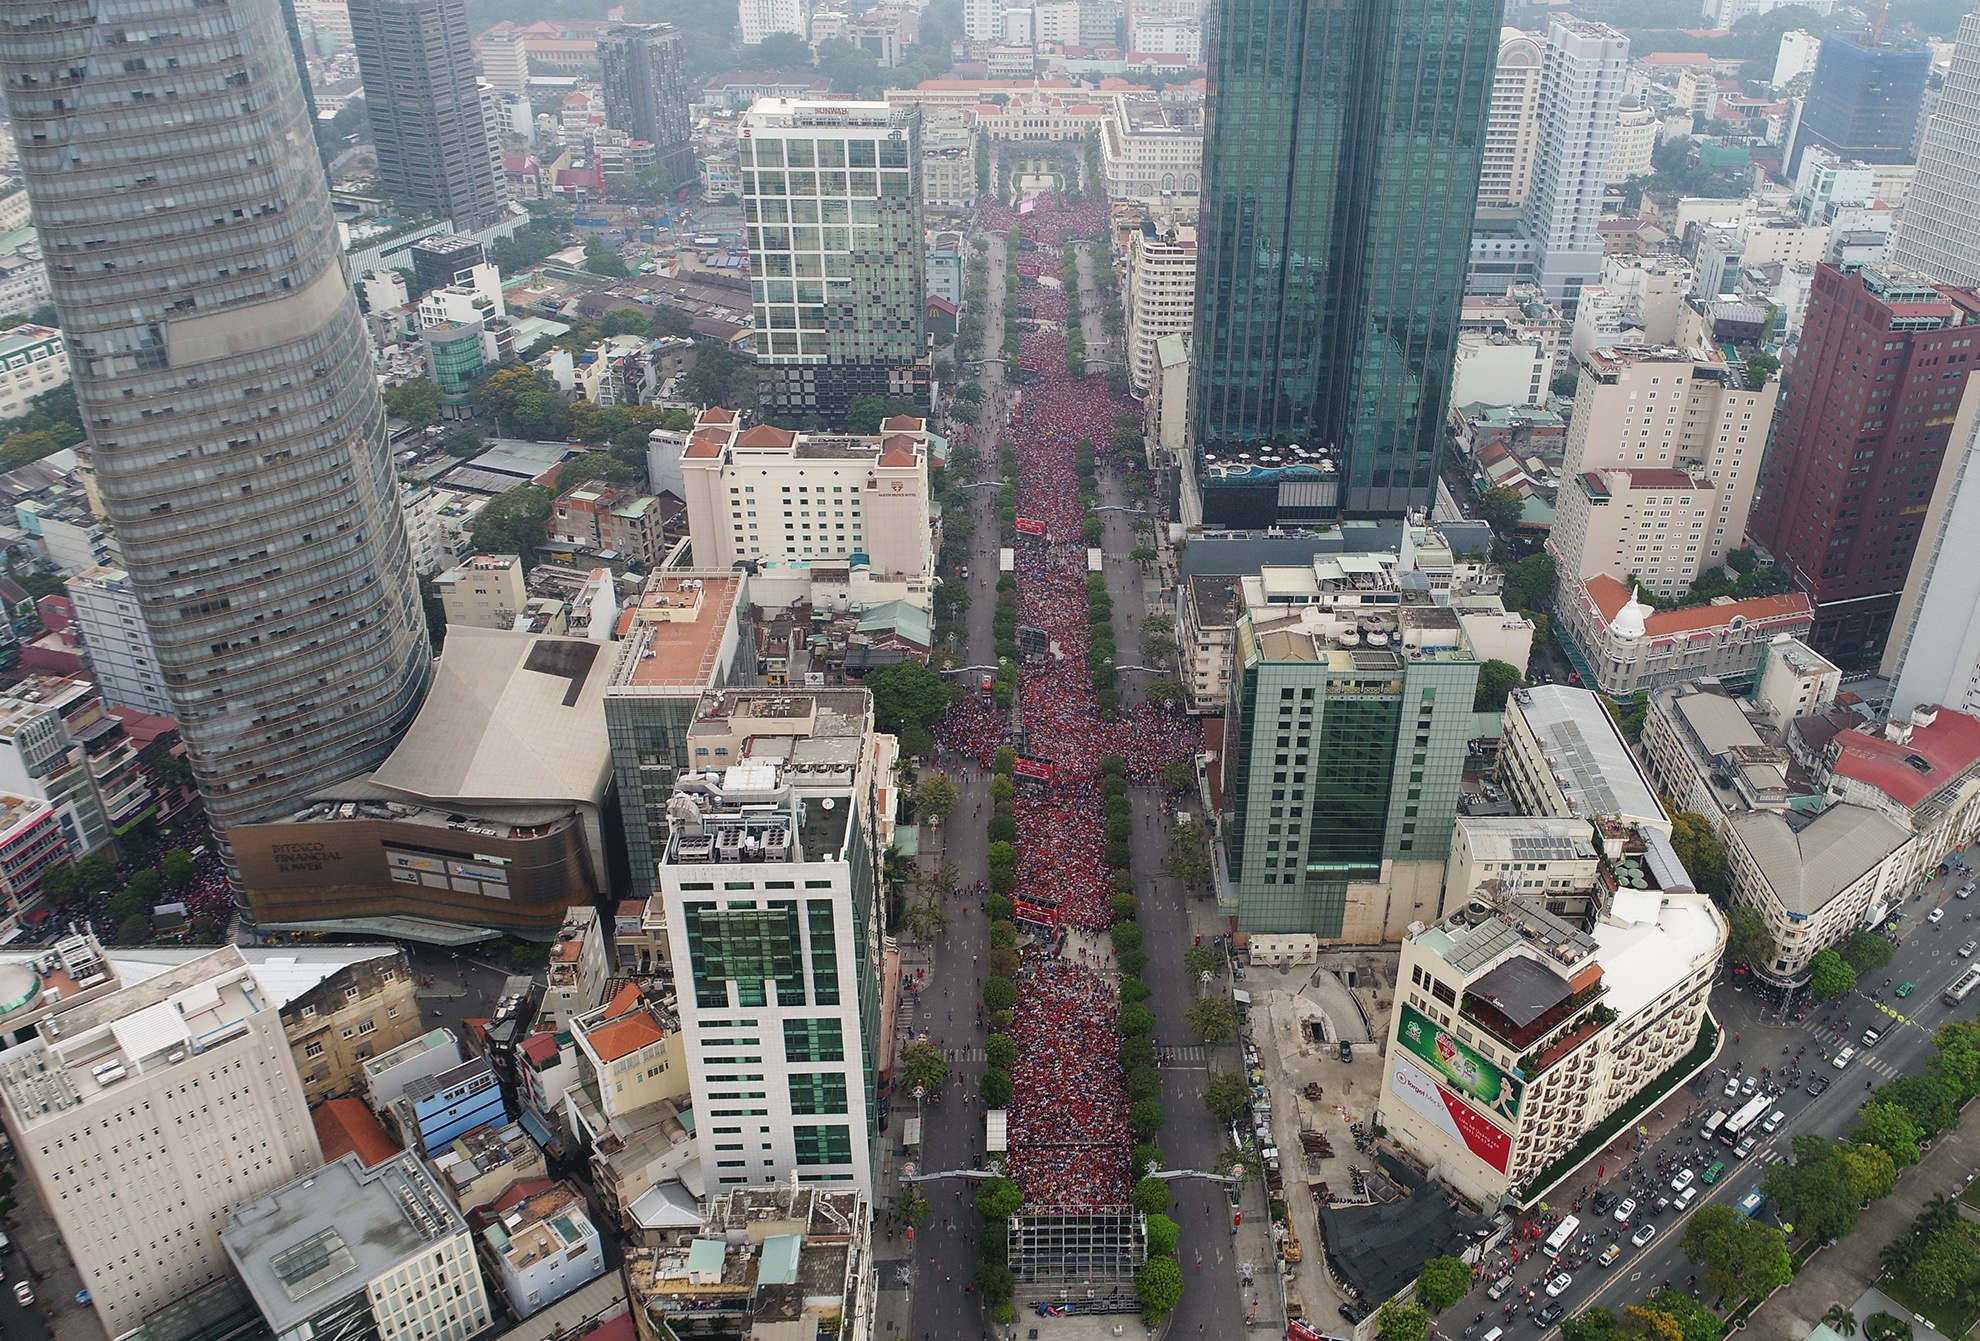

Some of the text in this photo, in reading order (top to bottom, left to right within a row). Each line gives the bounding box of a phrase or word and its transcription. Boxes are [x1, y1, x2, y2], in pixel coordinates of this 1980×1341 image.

[272, 842, 324, 853] BITEXCO
[273, 851, 343, 863] FINANCIAL
[276, 862, 322, 872] TOWER
[1407, 1079, 1444, 1110] Target Media
